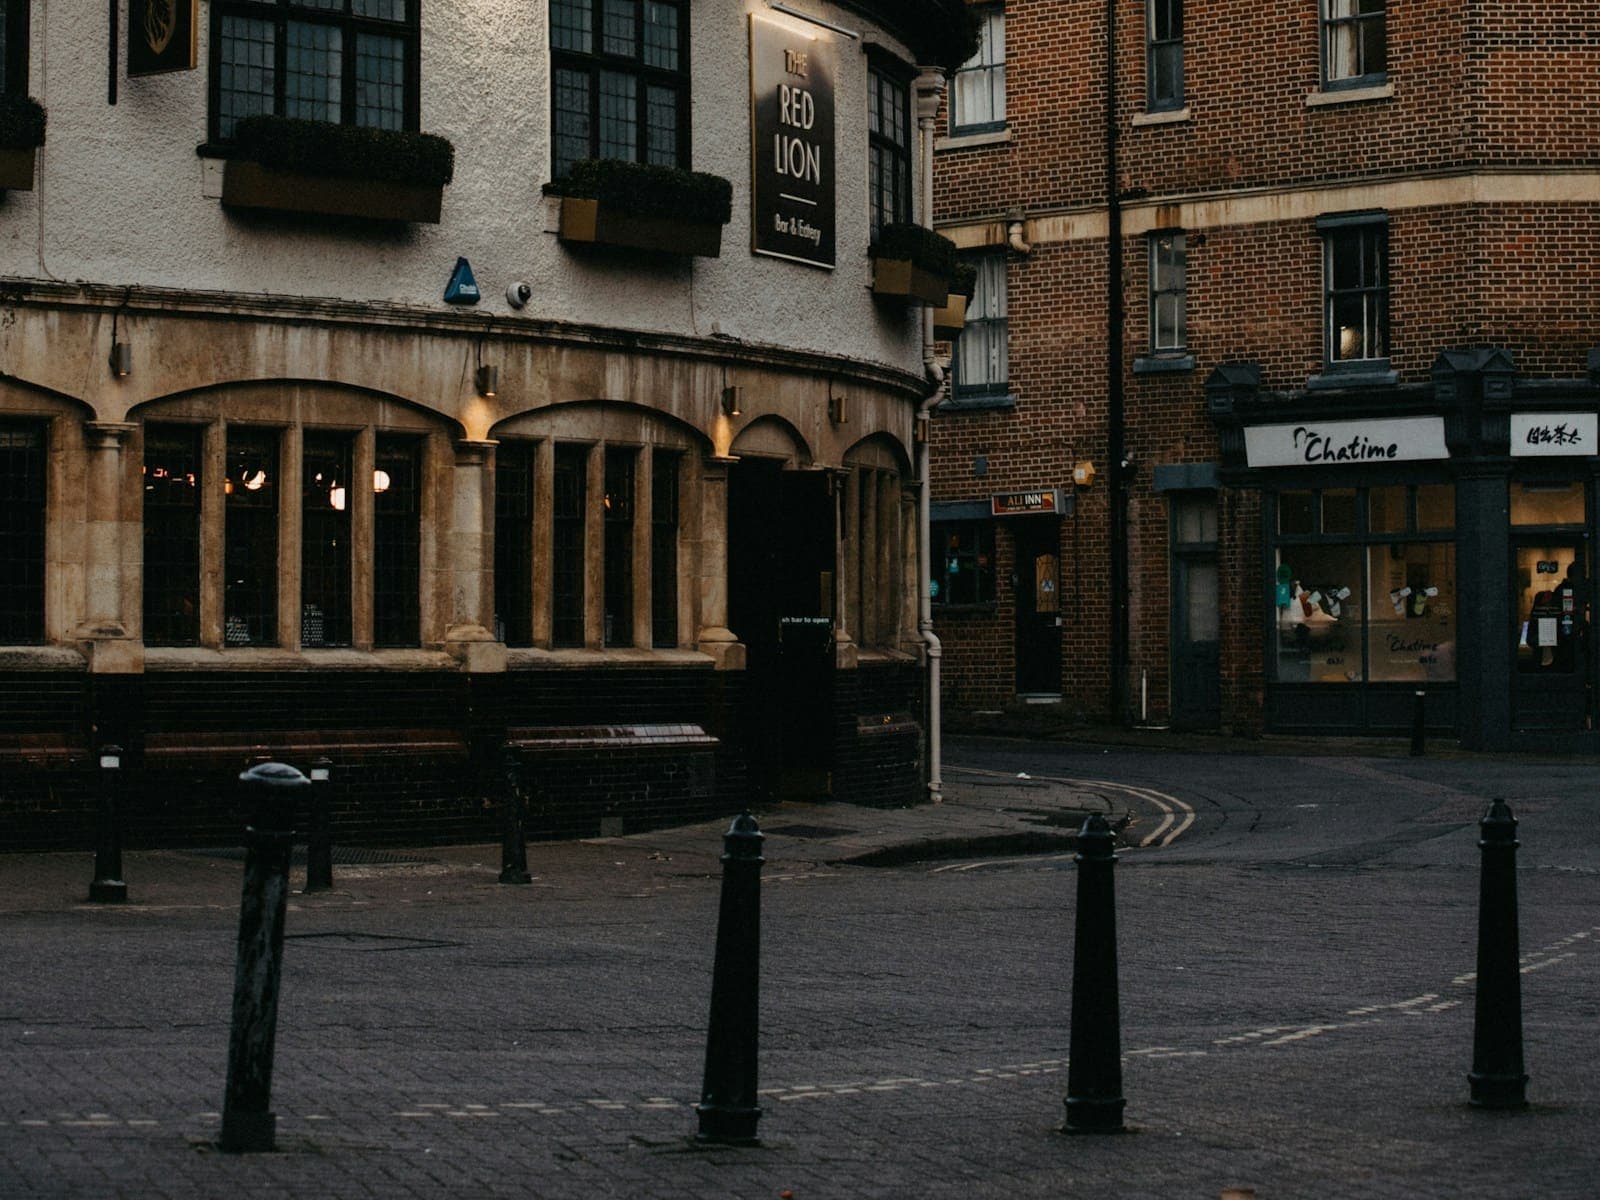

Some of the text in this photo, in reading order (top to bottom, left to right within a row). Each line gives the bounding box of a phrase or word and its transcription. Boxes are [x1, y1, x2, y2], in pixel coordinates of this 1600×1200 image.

[784, 49, 808, 78] THE
[779, 84, 815, 130] RED
[774, 133, 821, 185] LION
[774, 213, 789, 234] Bar
[790, 217, 797, 236] &
[1304, 435, 1398, 461] Chatime
[1025, 494, 1042, 505] INN
